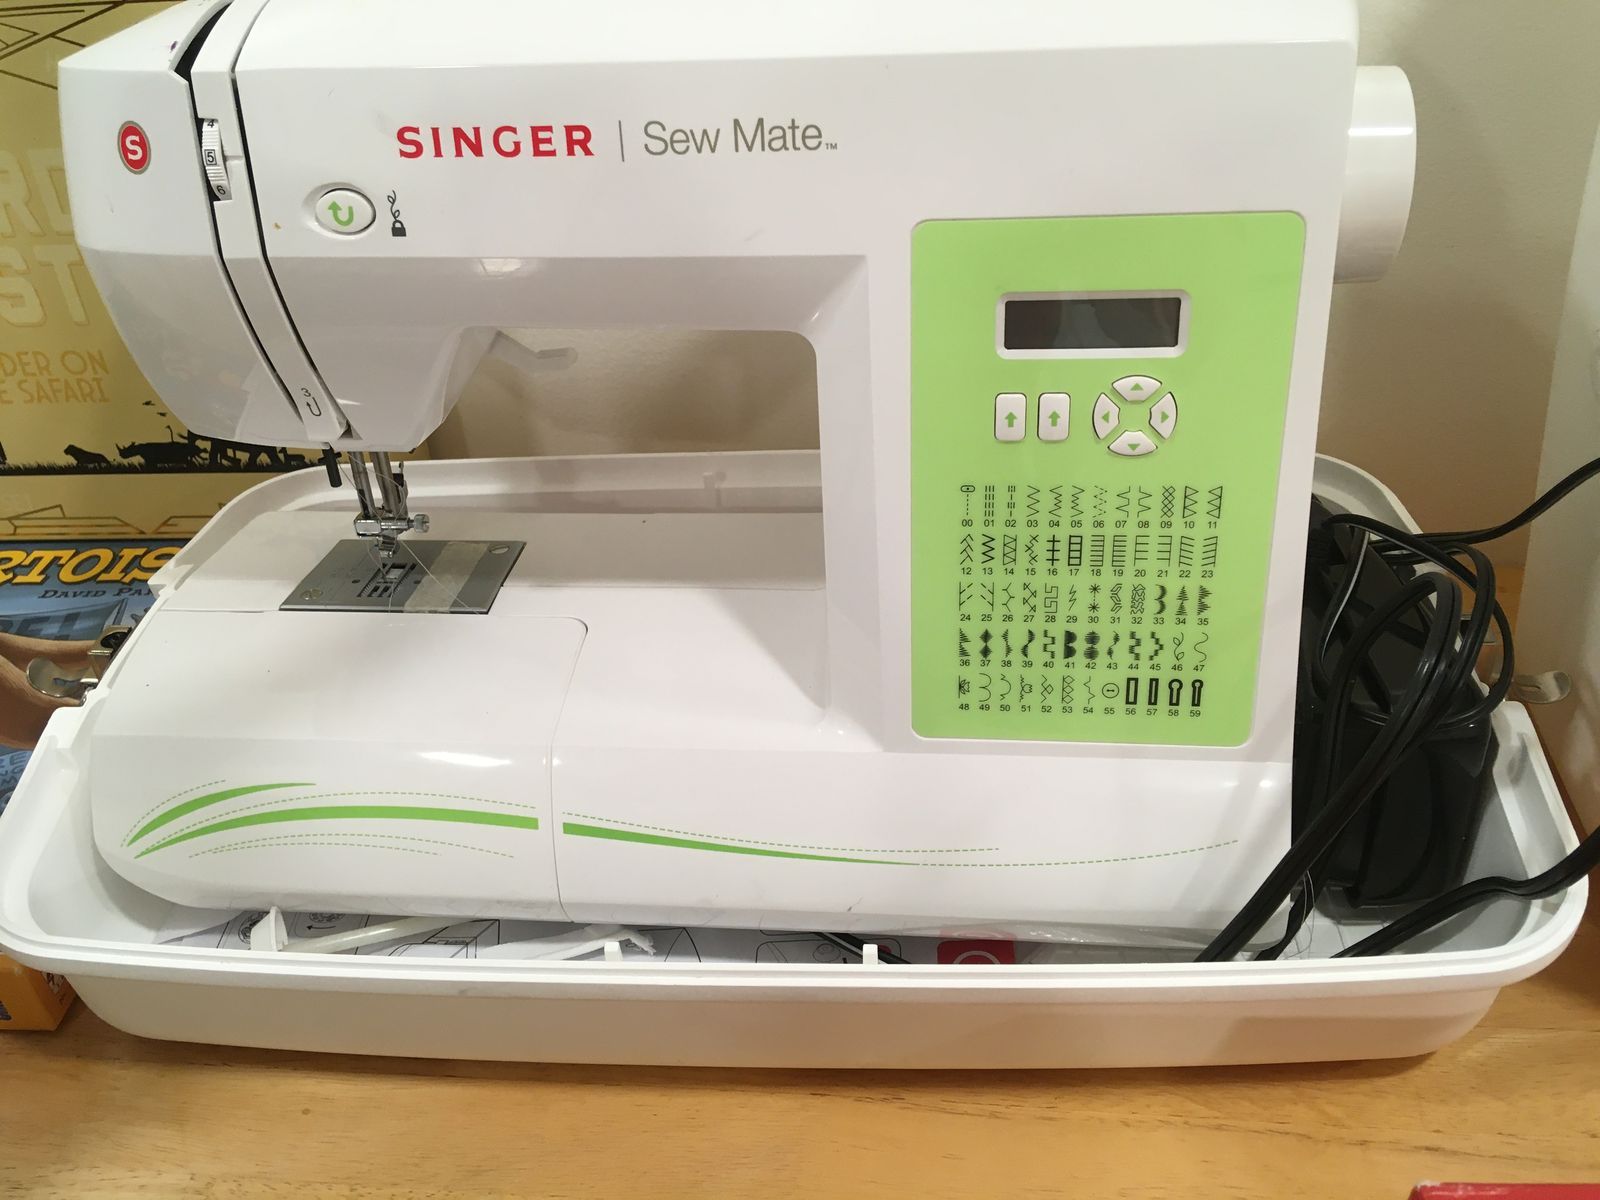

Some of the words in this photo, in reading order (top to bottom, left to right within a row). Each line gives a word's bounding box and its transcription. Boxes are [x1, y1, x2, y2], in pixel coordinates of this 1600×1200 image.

[207, 119, 215, 128] 4
[397, 125, 595, 159] SINGER
[643, 120, 721, 156] Sew
[125, 135, 143, 160] S
[206, 151, 215, 163] 5
[216, 185, 226, 195] 6
[60, 349, 110, 376] ON
[17, 376, 110, 404] SAFARI
[301, 387, 311, 397] 3
[962, 519, 973, 527] 00
[984, 519, 994, 527] 01
[1005, 519, 1016, 527] 02
[1027, 520, 1038, 528] 03
[1049, 520, 1060, 528] 04
[1071, 520, 1082, 528] 05
[1093, 520, 1104, 528] 06
[1115, 520, 1127, 528] 07
[1138, 520, 1149, 528] 08
[1160, 521, 1172, 529] 09
[1184, 521, 1195, 529] 10
[1208, 520, 1217, 528] 11
[961, 567, 972, 575] 12
[982, 567, 993, 575] 13
[1004, 567, 1014, 575] 14
[1025, 568, 1036, 576] 15
[1047, 568, 1058, 576] 16
[1069, 568, 1079, 576] 17
[1091, 568, 1101, 576] 18
[1113, 569, 1123, 577] 19
[1134, 569, 1146, 577] 20
[1157, 569, 1168, 577] 21
[1179, 570, 1191, 578] 22
[1201, 570, 1213, 578] 23
[960, 613, 971, 621] 24
[981, 613, 992, 621] 25
[1002, 614, 1013, 622] 26
[1024, 614, 1034, 622] 27
[1045, 615, 1056, 623] 28
[1066, 615, 1077, 623] 29
[1088, 615, 1099, 623] 30
[1110, 616, 1120, 624] 31
[1131, 616, 1143, 624] 32
[1153, 617, 1164, 625] 33
[1175, 617, 1186, 625] 34
[1197, 617, 1209, 625] 35
[960, 660, 970, 668] 36
[980, 659, 991, 667] 37
[1001, 659, 1012, 667] 38
[1022, 660, 1033, 668] 39
[1043, 660, 1054, 668] 40
[1065, 661, 1074, 669] 41
[1085, 661, 1096, 669] 42
[1106, 662, 1118, 670] 43
[1128, 662, 1139, 670] 44
[1149, 663, 1161, 671] 45
[1171, 663, 1183, 671] 46
[1193, 664, 1205, 672] 47
[959, 702, 969, 710] 48
[979, 703, 991, 711] 49
[1000, 703, 1010, 711] 50
[1021, 704, 1031, 712] 51
[1041, 705, 1052, 713] 52
[1062, 705, 1072, 713] 53
[1083, 706, 1093, 714] 54
[1104, 706, 1115, 714] 55
[1125, 707, 1136, 715] 56
[1146, 707, 1157, 715] 57
[1168, 708, 1179, 716] 58
[1190, 709, 1201, 717] 59
